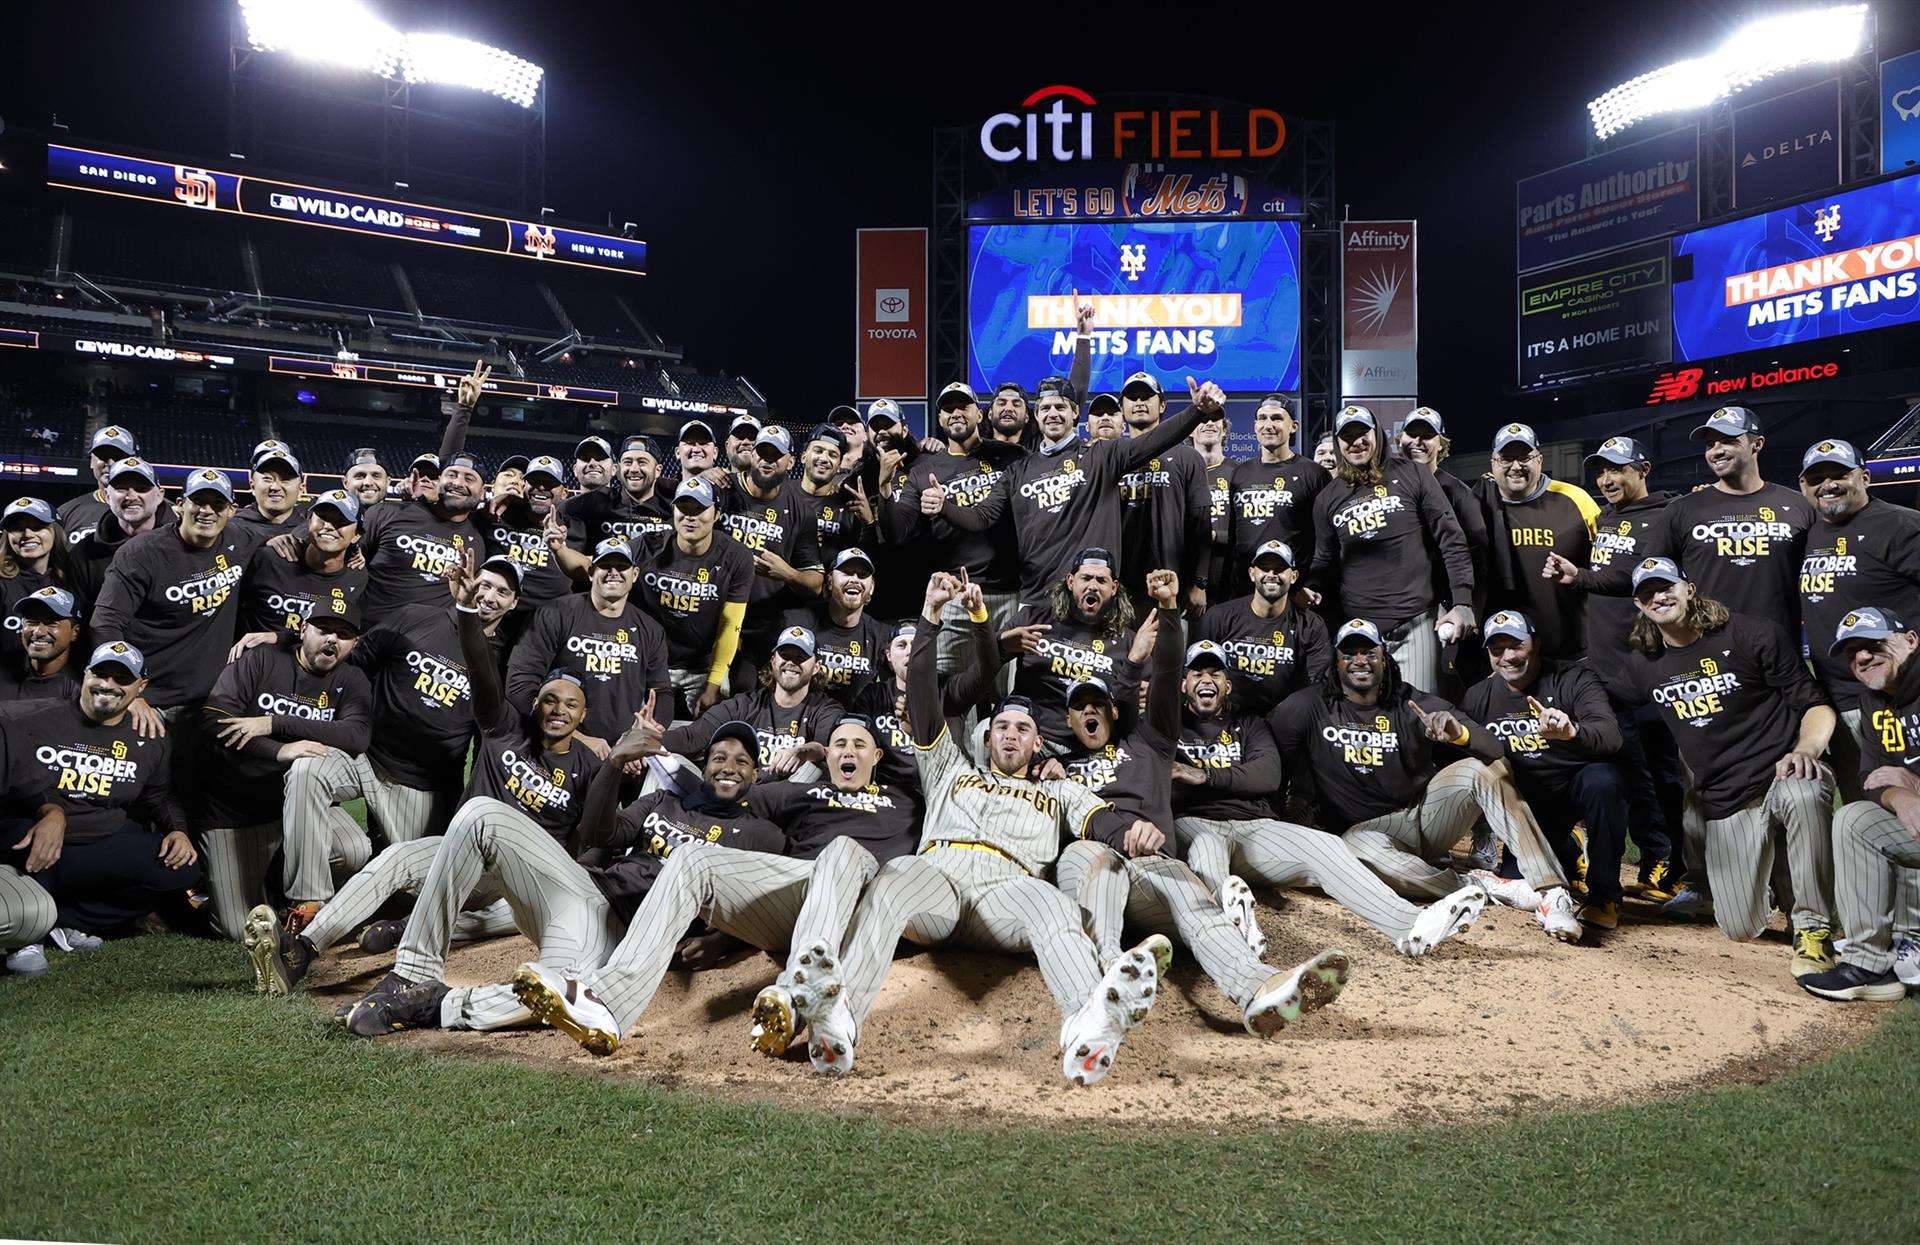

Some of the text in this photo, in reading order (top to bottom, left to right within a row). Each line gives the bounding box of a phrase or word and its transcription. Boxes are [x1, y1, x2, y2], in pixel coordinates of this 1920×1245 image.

[980, 98, 1287, 162] citi FIELD
[1763, 129, 1833, 160] DELTA
[79, 165, 157, 186] SAN DIEGO
[1013, 173, 1227, 217] LET'S GO Mets
[1519, 160, 1690, 227] Parts Authority
[1262, 200, 1285, 213] citi
[571, 242, 625, 260] NEW YORK
[1347, 230, 1410, 250] Affinity
[1529, 266, 1656, 306] EMPIRE CITY
[1727, 253, 1850, 304] THANK
[1162, 296, 1239, 325] YOU
[1567, 290, 1614, 307] CASINO
[1748, 272, 1918, 327] METS FANS
[866, 328, 917, 340] TOYOTA
[1136, 330, 1216, 355] FANS
[1527, 319, 1660, 358] IT'S A HOME RUN
[1364, 365, 1408, 381] Affinity
[1707, 375, 1747, 395] new
[1750, 362, 1839, 389] balance
[1019, 469, 1087, 498] OCTOBER
[1037, 487, 1072, 510] RISE
[1243, 502, 1274, 518] RISE
[1333, 495, 1404, 527] OCTOBER
[1348, 511, 1388, 536] RISE
[1691, 521, 1793, 541] OCTOBER
[1512, 527, 1554, 547] DRES
[1717, 536, 1770, 556] RISE
[508, 544, 549, 567] RISE
[165, 564, 243, 602] OCTOBER
[644, 572, 719, 598] OCTOBER
[1800, 572, 1835, 593] RISE
[660, 590, 701, 613] RISE
[567, 635, 640, 660] OCTOBER
[1035, 638, 1113, 672] OCTOBER
[1221, 640, 1294, 662] OCTOBER
[585, 653, 622, 675] RISE
[1237, 657, 1275, 676] RISE
[413, 672, 461, 708] RISE
[1652, 672, 1742, 704] OCTOBER
[1671, 692, 1724, 721] RISE
[1344, 745, 1384, 767] RISE
[1508, 734, 1550, 753] RISE
[36, 745, 138, 779] OCTOBER
[57, 767, 114, 797] RISE
[501, 749, 572, 809] OCTOBER
[504, 774, 548, 814] RISE
[998, 785, 1059, 821] DIEGO
